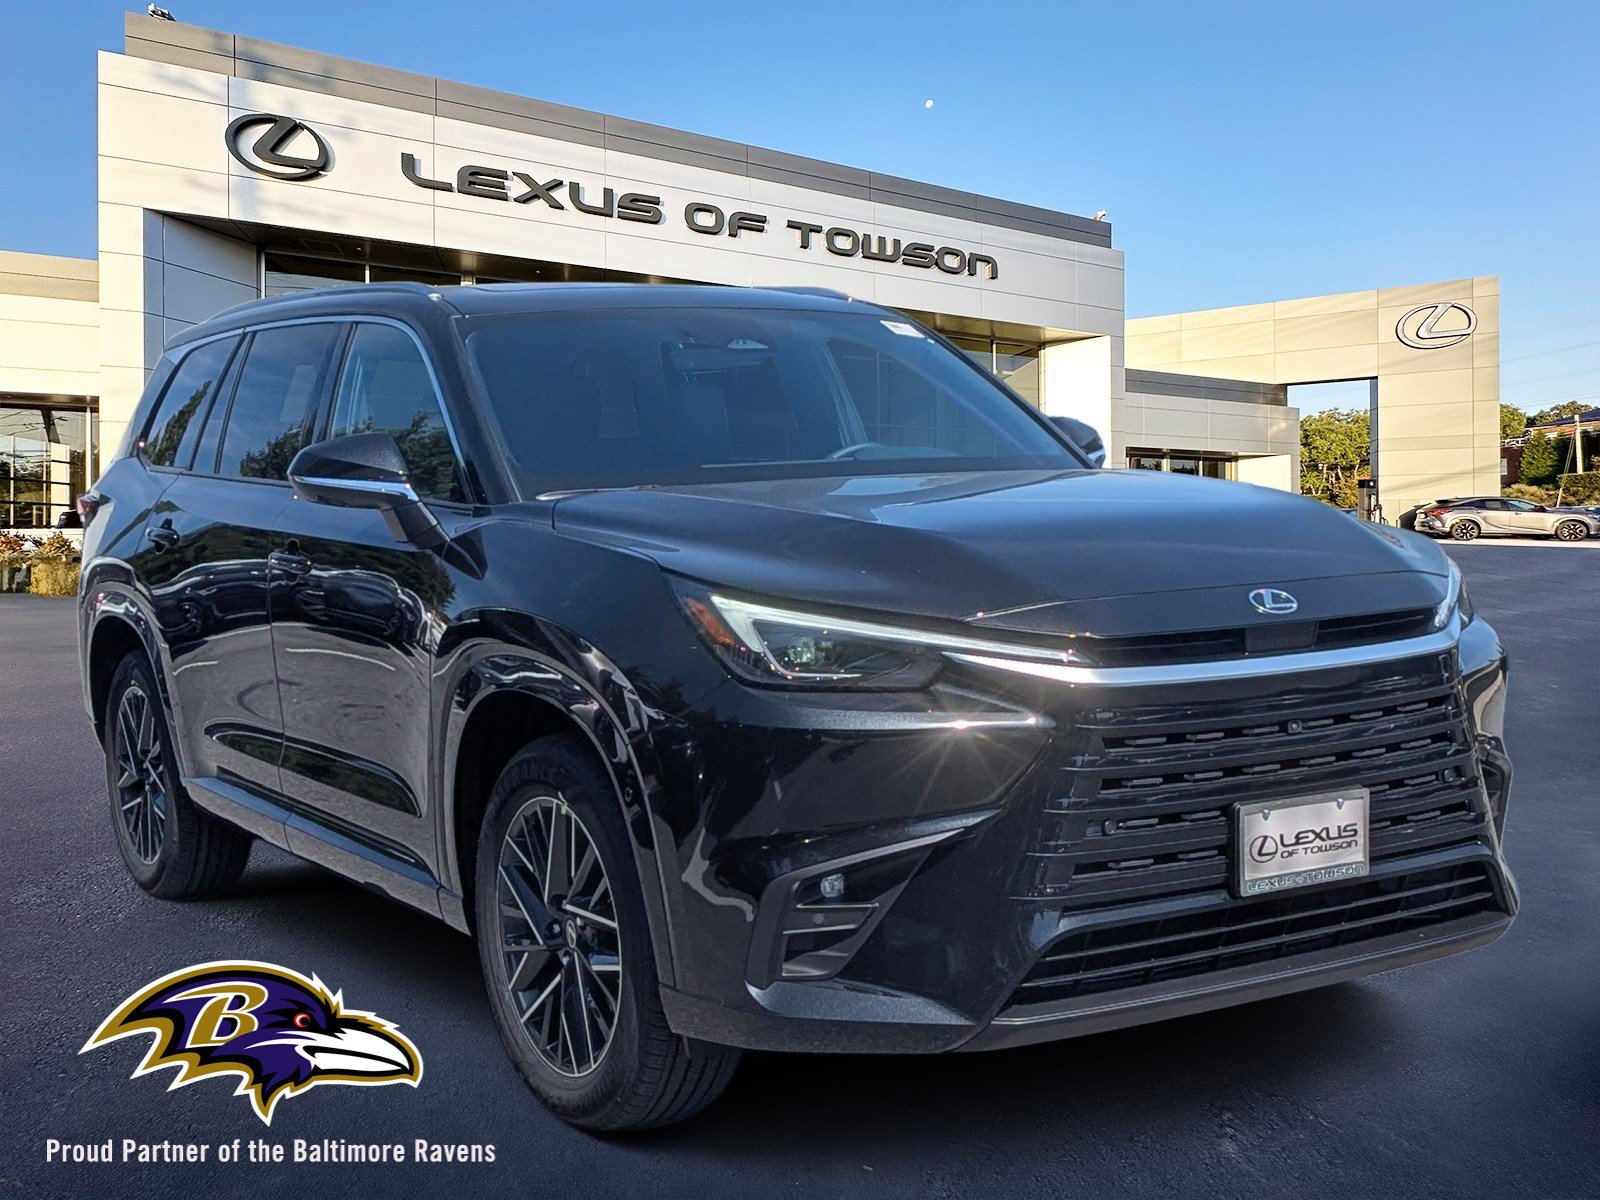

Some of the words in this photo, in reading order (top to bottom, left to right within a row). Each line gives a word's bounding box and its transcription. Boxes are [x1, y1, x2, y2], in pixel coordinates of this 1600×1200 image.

[401, 152, 662, 225] LEXUS
[684, 202, 768, 238] OF
[786, 219, 999, 280] TOWSON
[1279, 823, 1358, 848] LEXUS
[1280, 848, 1299, 859] OF
[1303, 839, 1358, 856] TOWSON
[1247, 874, 1297, 893] LEXUS
[1304, 864, 1365, 884] TOWSON
